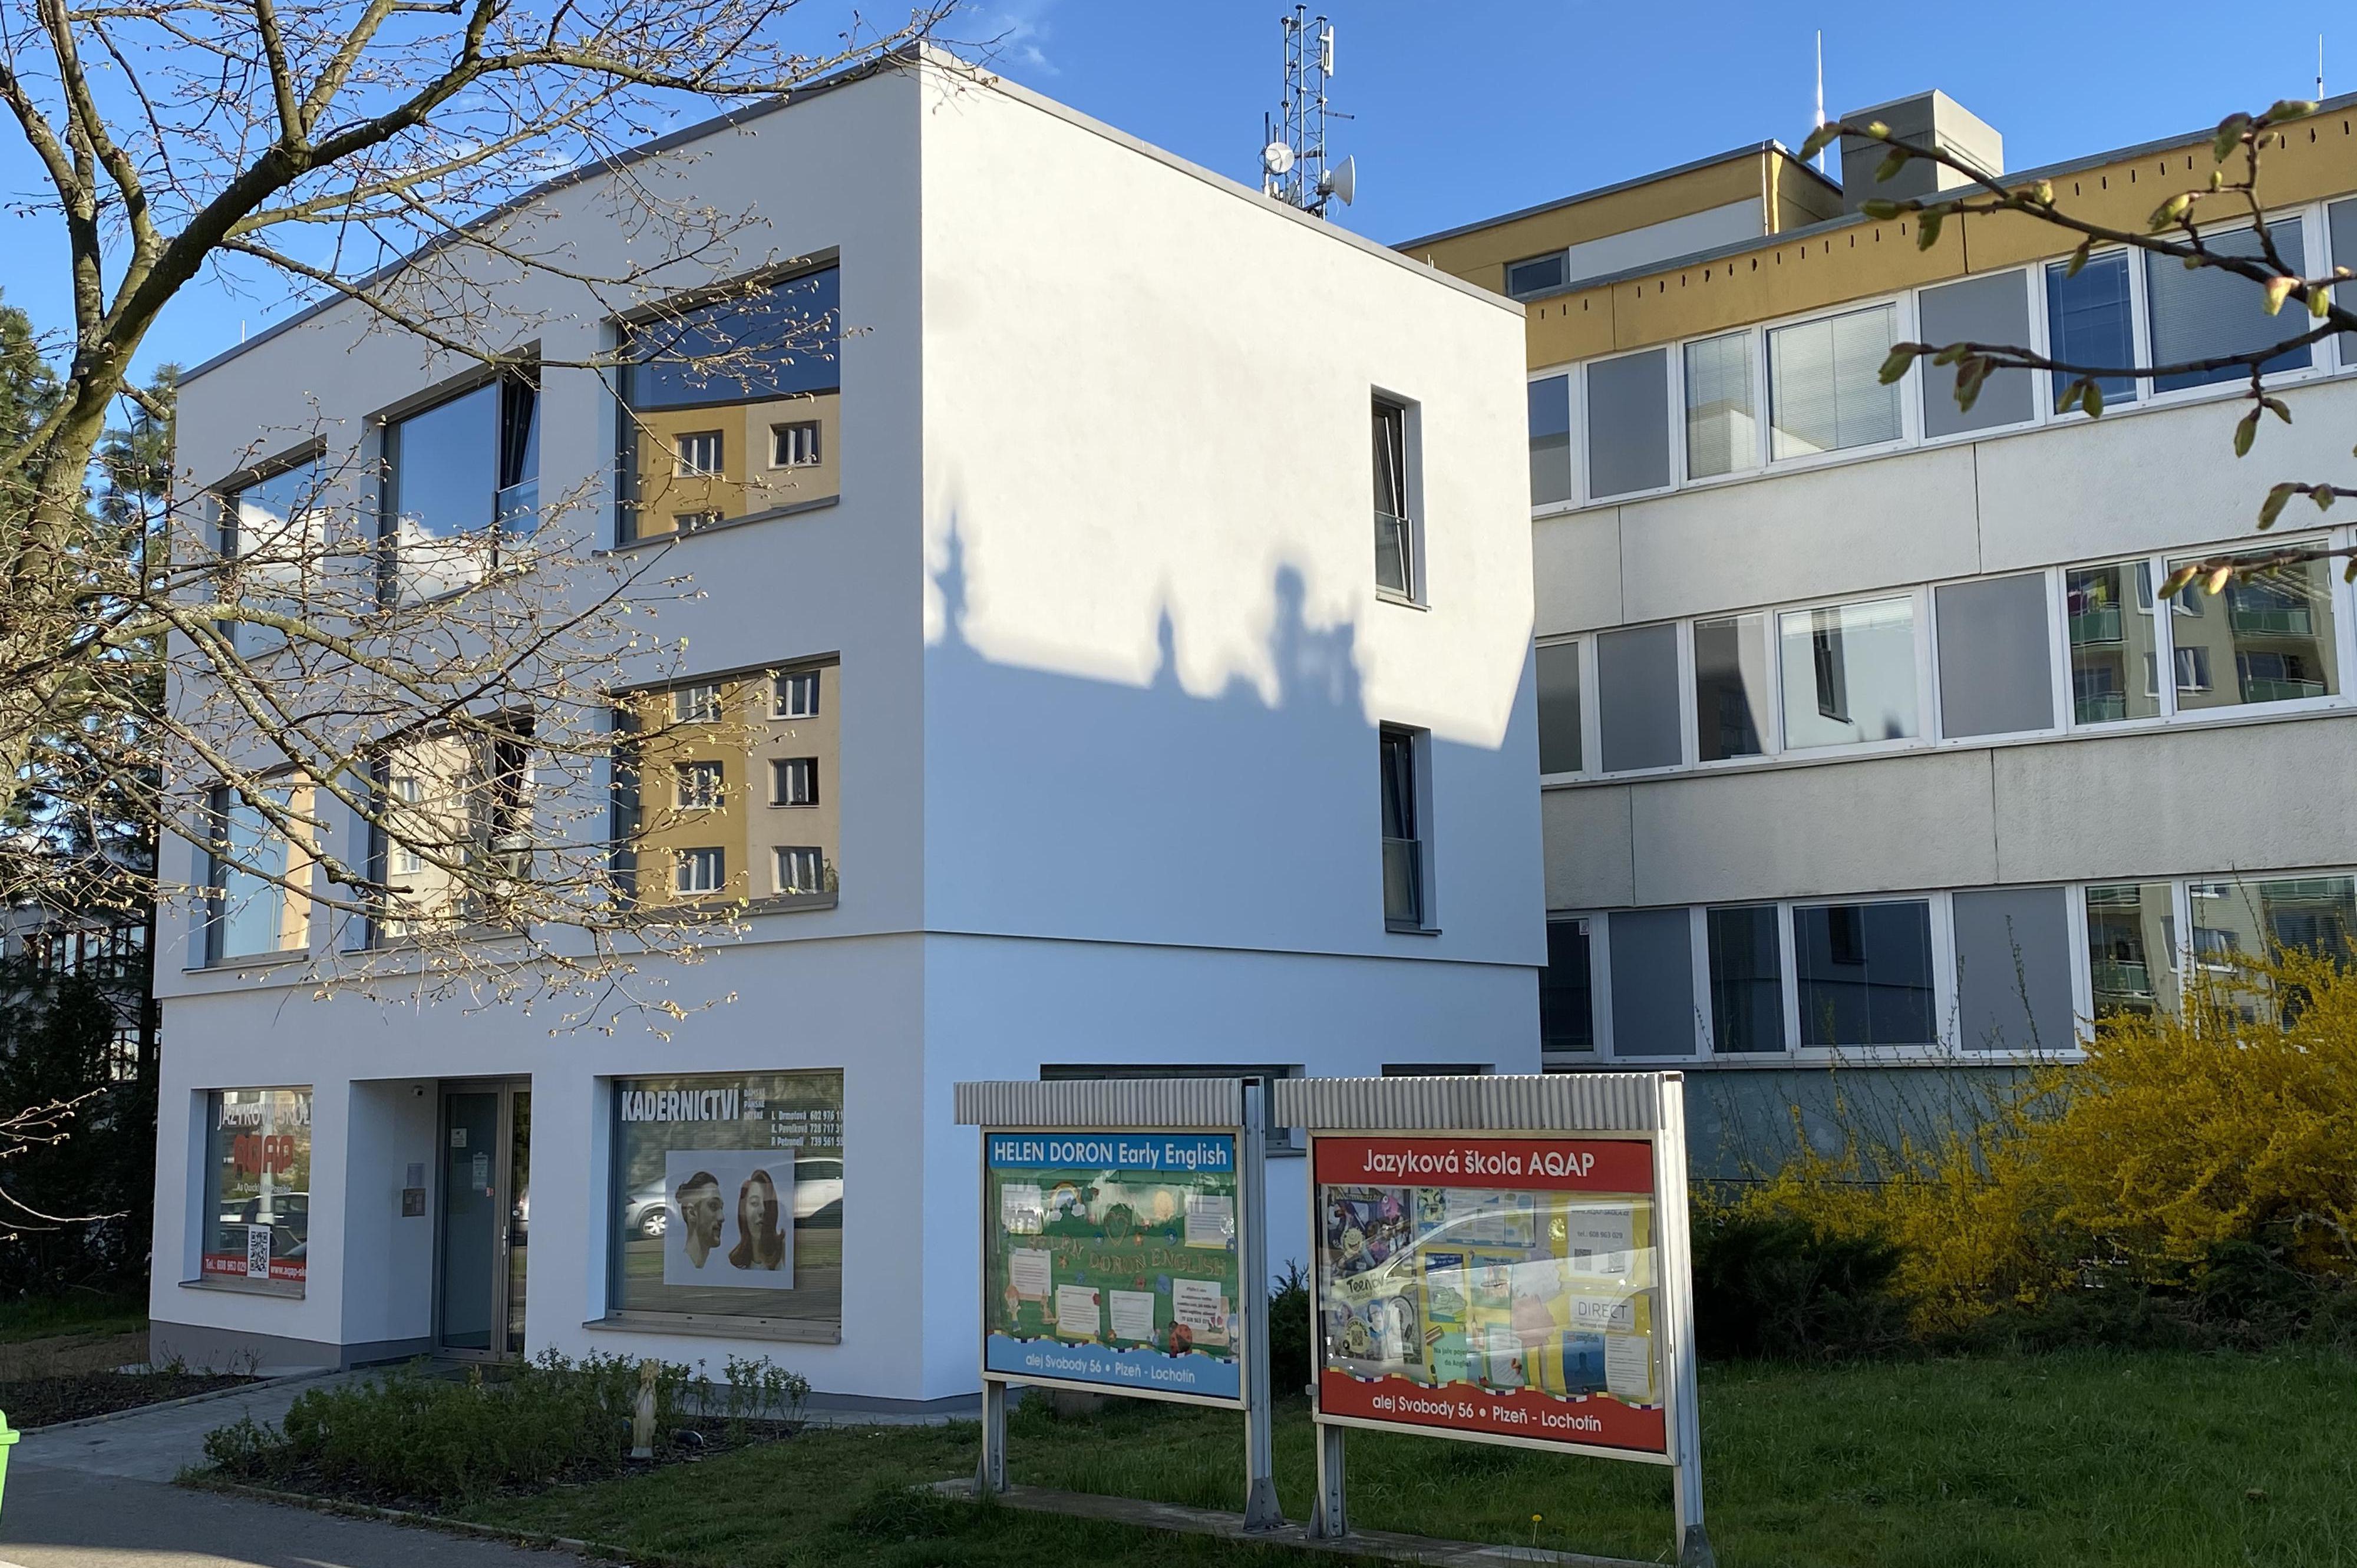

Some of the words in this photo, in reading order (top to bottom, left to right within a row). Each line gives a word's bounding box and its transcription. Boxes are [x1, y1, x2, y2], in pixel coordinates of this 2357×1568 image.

[622, 1082, 740, 1121] KADEŘNICTVÍ
[233, 1134, 295, 1176] AQAP
[995, 1142, 1044, 1162] HELEN
[1050, 1142, 1113, 1163] DORON
[1120, 1143, 1160, 1170] Early
[1165, 1143, 1227, 1170] English
[1363, 1149, 1458, 1177] Jazyková
[1465, 1150, 1521, 1175] škola
[1528, 1151, 1595, 1177] AQAP
[1579, 1302, 1628, 1319] DIRECT
[1026, 1354, 1043, 1369] alej
[1045, 1355, 1087, 1374] Svobody
[1090, 1359, 1101, 1373] 56
[1115, 1362, 1141, 1377] Plzeň
[1151, 1365, 1195, 1384] Lochotín
[1372, 1395, 1395, 1412] alej
[1399, 1396, 1454, 1420] Svobody
[1458, 1402, 1474, 1418] 56
[1493, 1405, 1528, 1425] Plzeň
[1541, 1410, 1602, 1432] Lochotín
